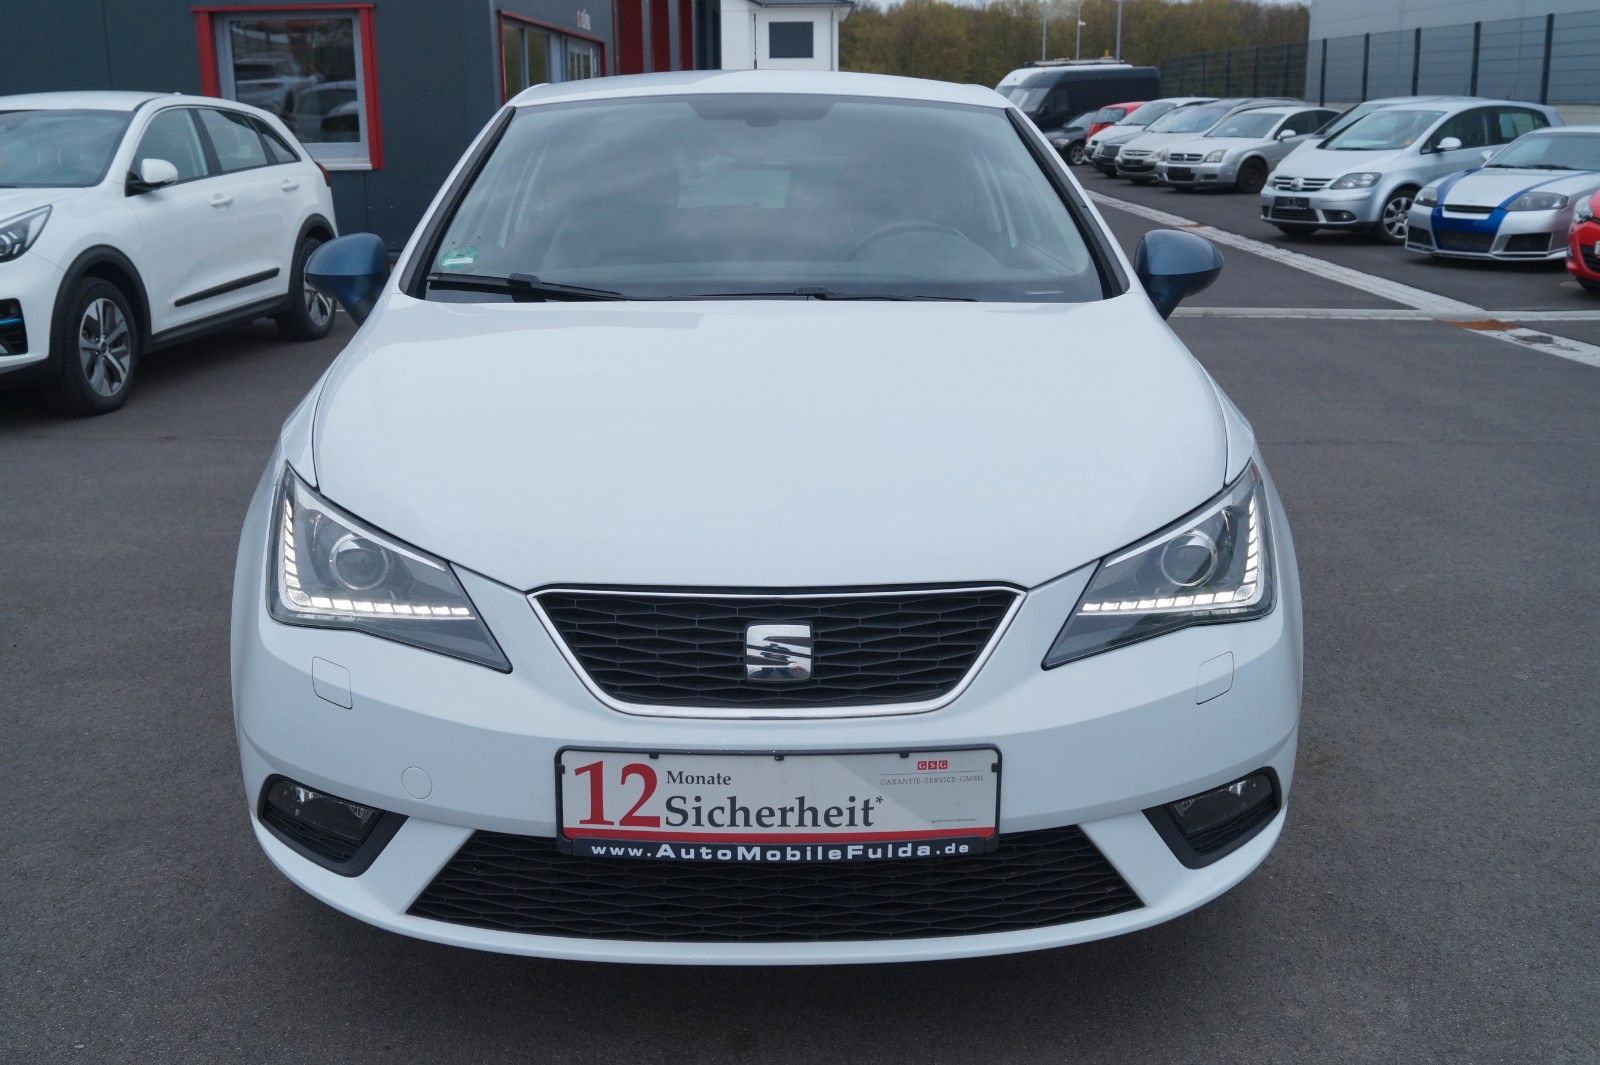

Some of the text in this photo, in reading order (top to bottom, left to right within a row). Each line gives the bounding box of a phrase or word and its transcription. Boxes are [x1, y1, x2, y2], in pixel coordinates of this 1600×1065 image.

[917, 760, 948, 770] GSG
[666, 770, 732, 786] Monate
[574, 760, 661, 828] 12
[591, 842, 970, 861] www.AutoMobileFulda.de
